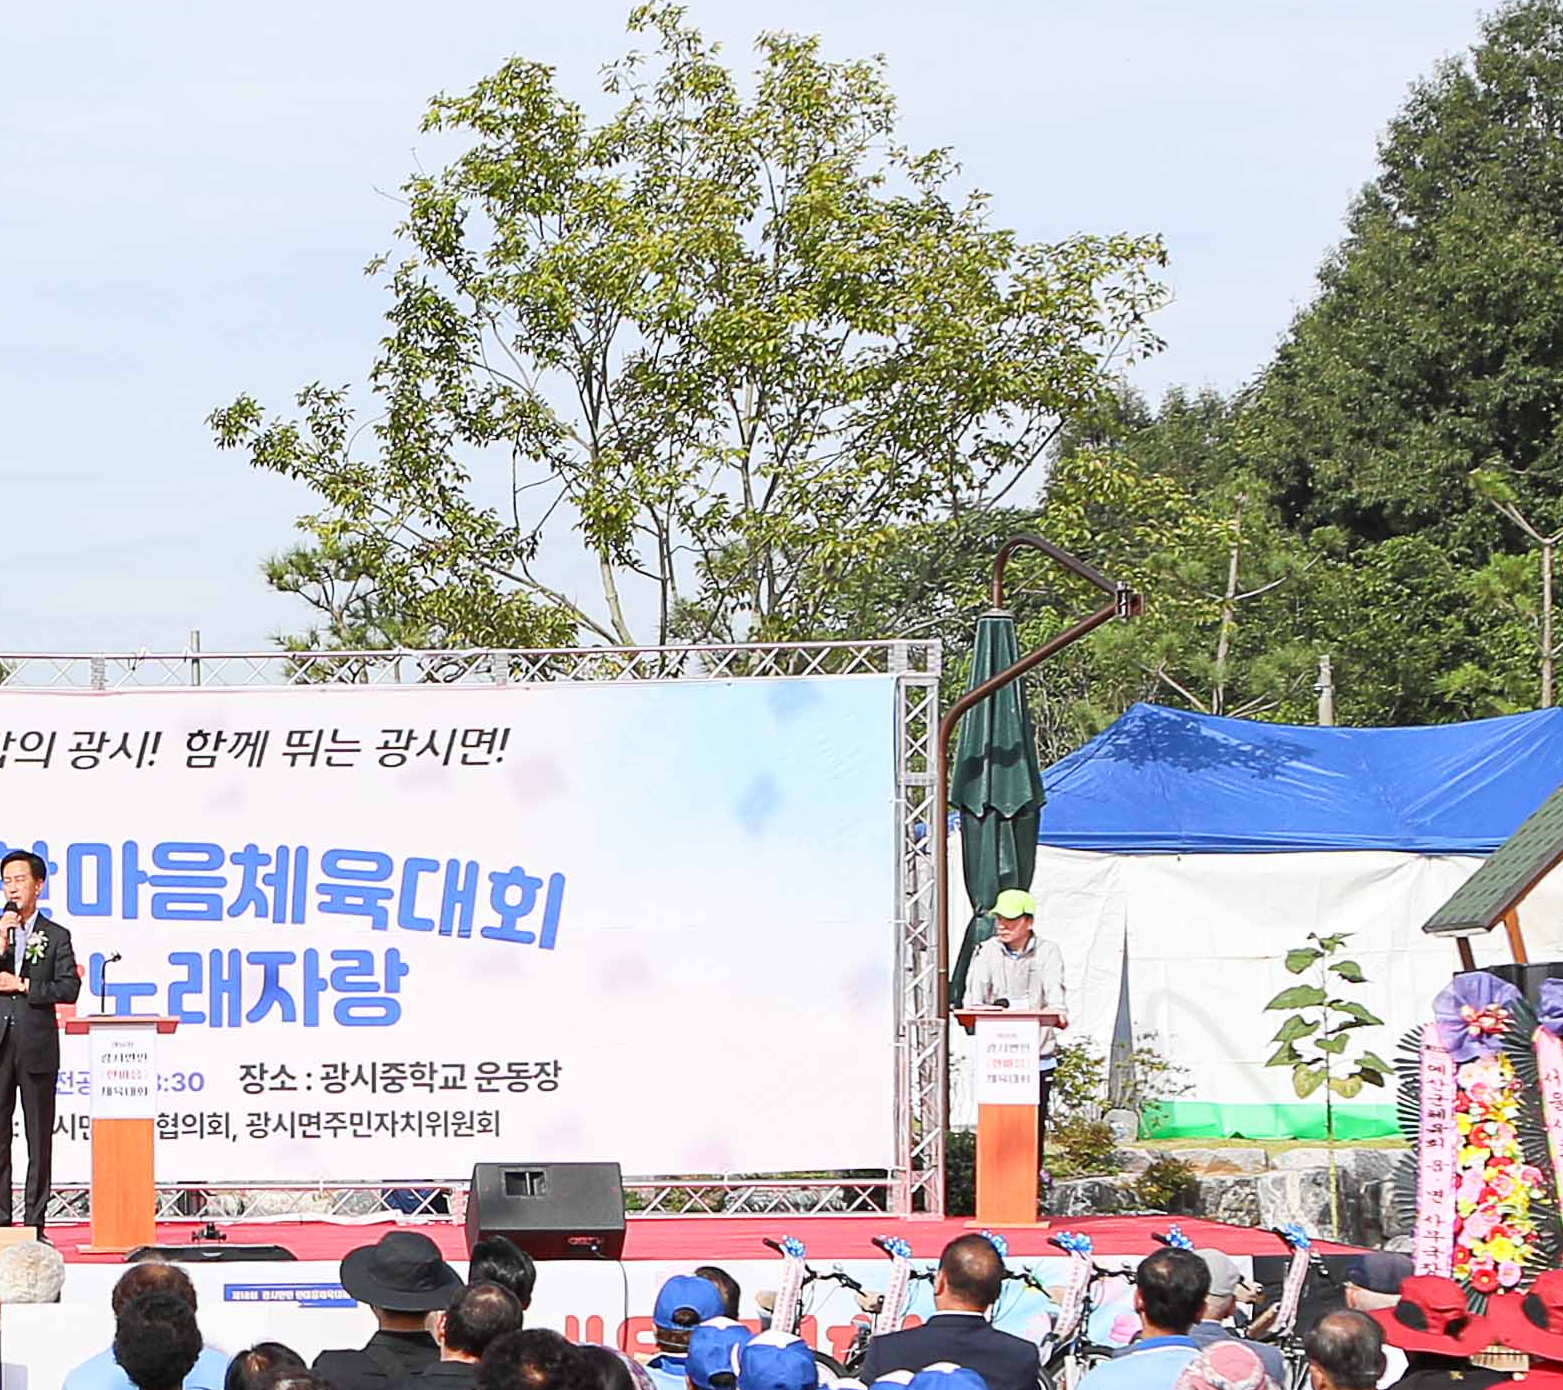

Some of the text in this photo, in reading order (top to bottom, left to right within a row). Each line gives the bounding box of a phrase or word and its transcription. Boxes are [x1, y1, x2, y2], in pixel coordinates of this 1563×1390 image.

[68, 729, 162, 770] 광시!
[185, 729, 267, 768] 함께
[281, 728, 363, 768] 뛰는
[376, 728, 510, 768] 광시면!
[157, 1072, 205, 1092] :30
[319, 1061, 467, 1095] 광시중학교
[474, 1058, 562, 1094] 운동장
[245, 1109, 500, 1141] 광시면주민자치위원회
